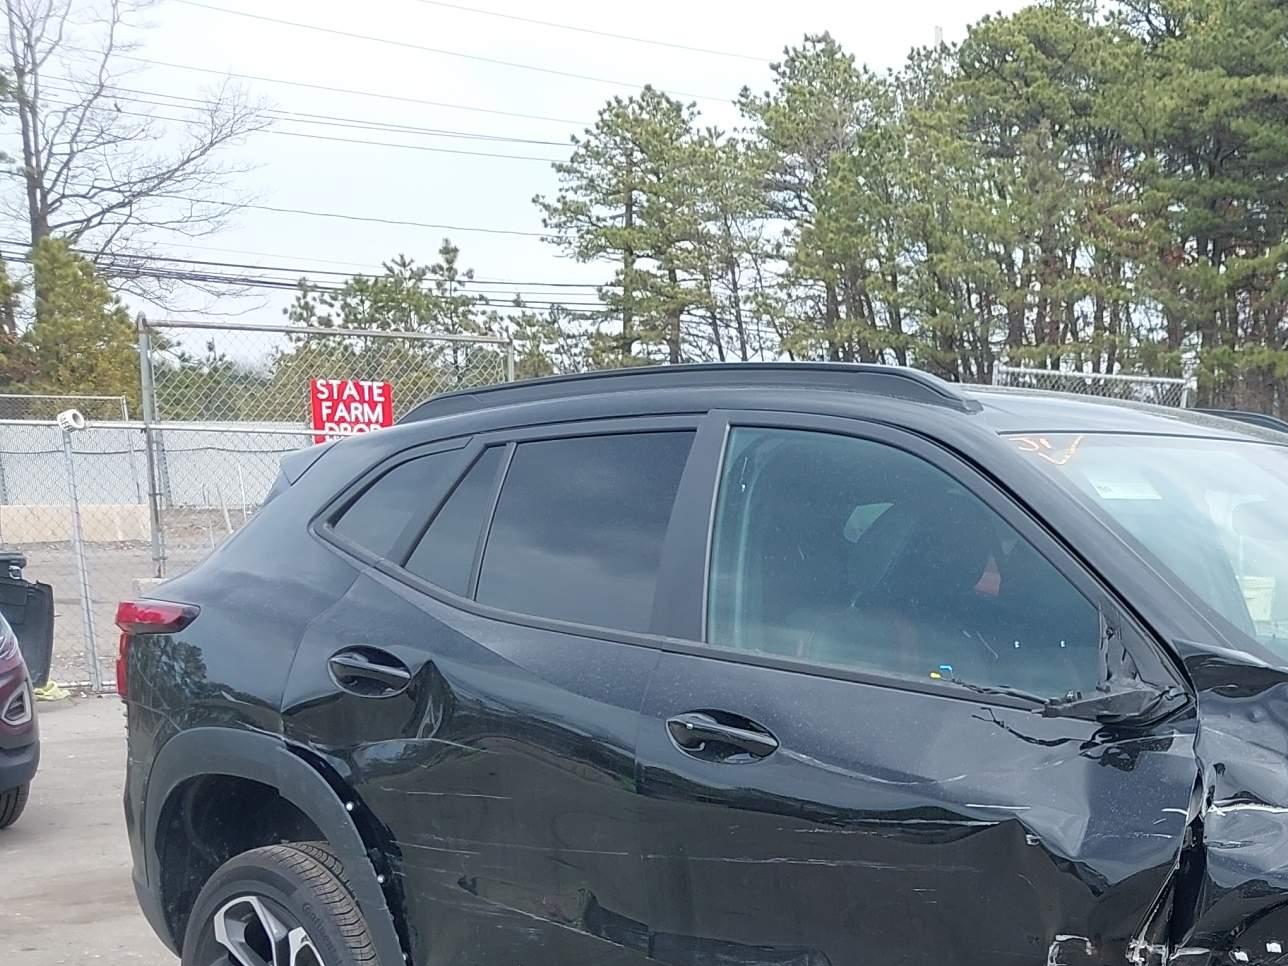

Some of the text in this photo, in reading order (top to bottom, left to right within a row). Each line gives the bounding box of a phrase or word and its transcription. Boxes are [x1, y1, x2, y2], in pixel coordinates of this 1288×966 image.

[316, 379, 385, 402] STATE
[321, 401, 384, 423] FARM
[324, 422, 382, 441] DR
